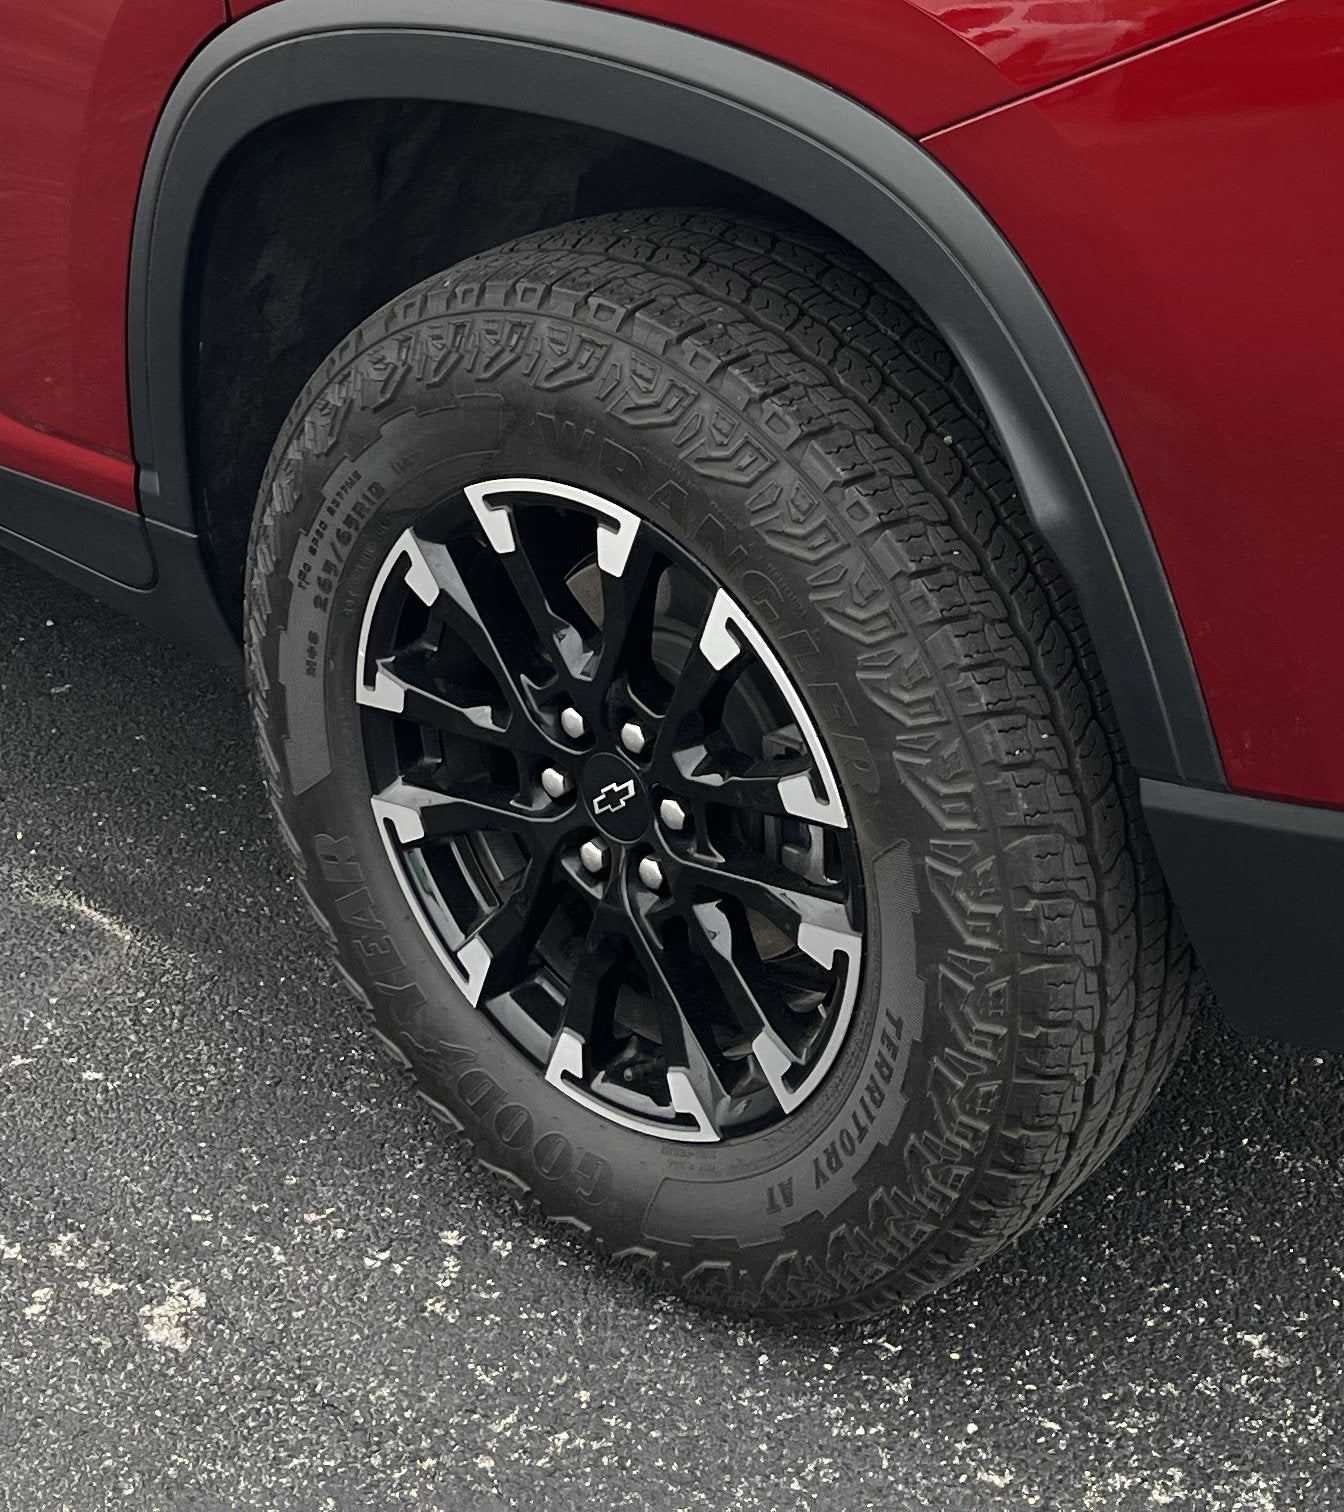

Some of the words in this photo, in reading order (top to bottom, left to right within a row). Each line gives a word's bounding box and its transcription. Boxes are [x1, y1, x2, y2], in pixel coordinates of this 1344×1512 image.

[534, 411, 882, 795] WRANGLER
[313, 832, 612, 1207] GOODYEAR
[810, 1007, 905, 1191] TERRITORY
[763, 1176, 796, 1215] AT
